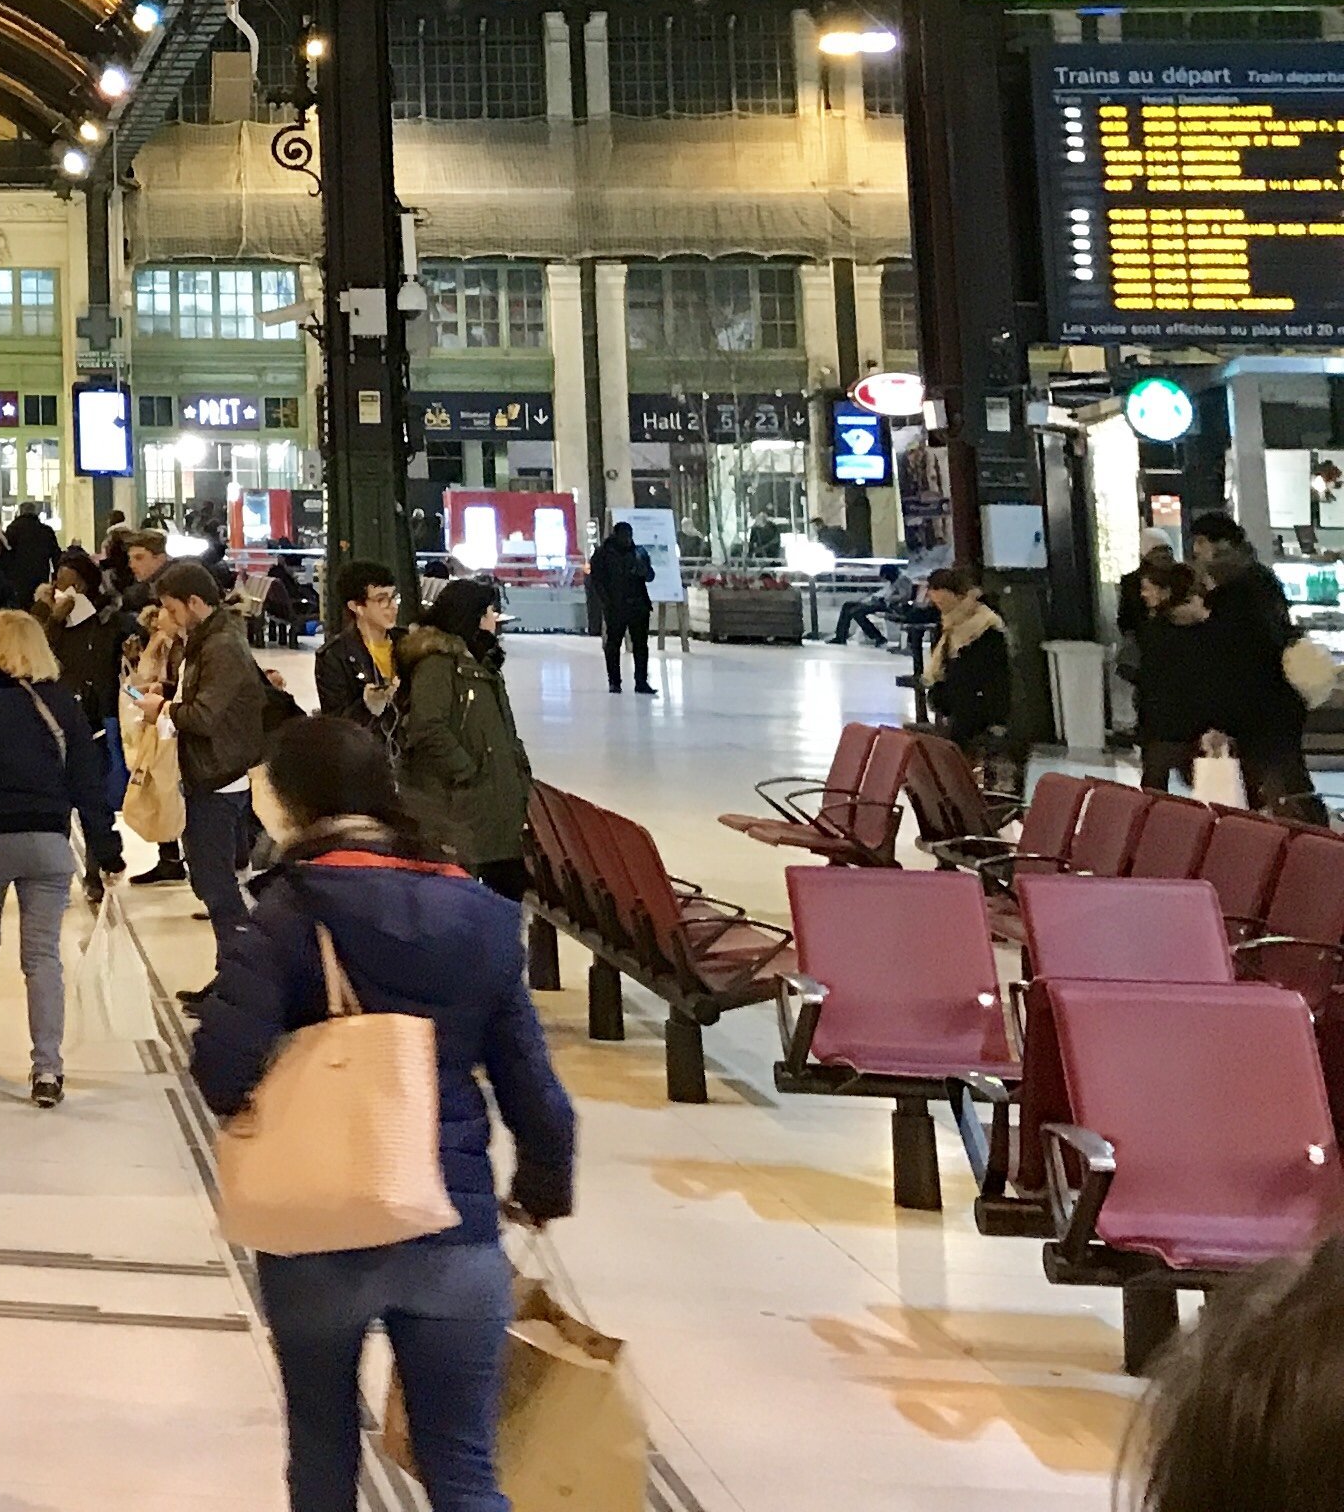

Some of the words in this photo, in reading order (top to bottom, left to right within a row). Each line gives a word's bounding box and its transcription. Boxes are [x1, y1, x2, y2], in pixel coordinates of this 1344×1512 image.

[1053, 66, 1120, 85] Trains
[1128, 70, 1154, 85] au
[1161, 65, 1232, 87] départ
[1247, 69, 1284, 84] Train
[1130, 322, 1162, 336] sont
[1284, 321, 1312, 336] tard
[198, 397, 241, 426] PRET
[643, 411, 682, 430] Hall
[687, 412, 701, 430] 2
